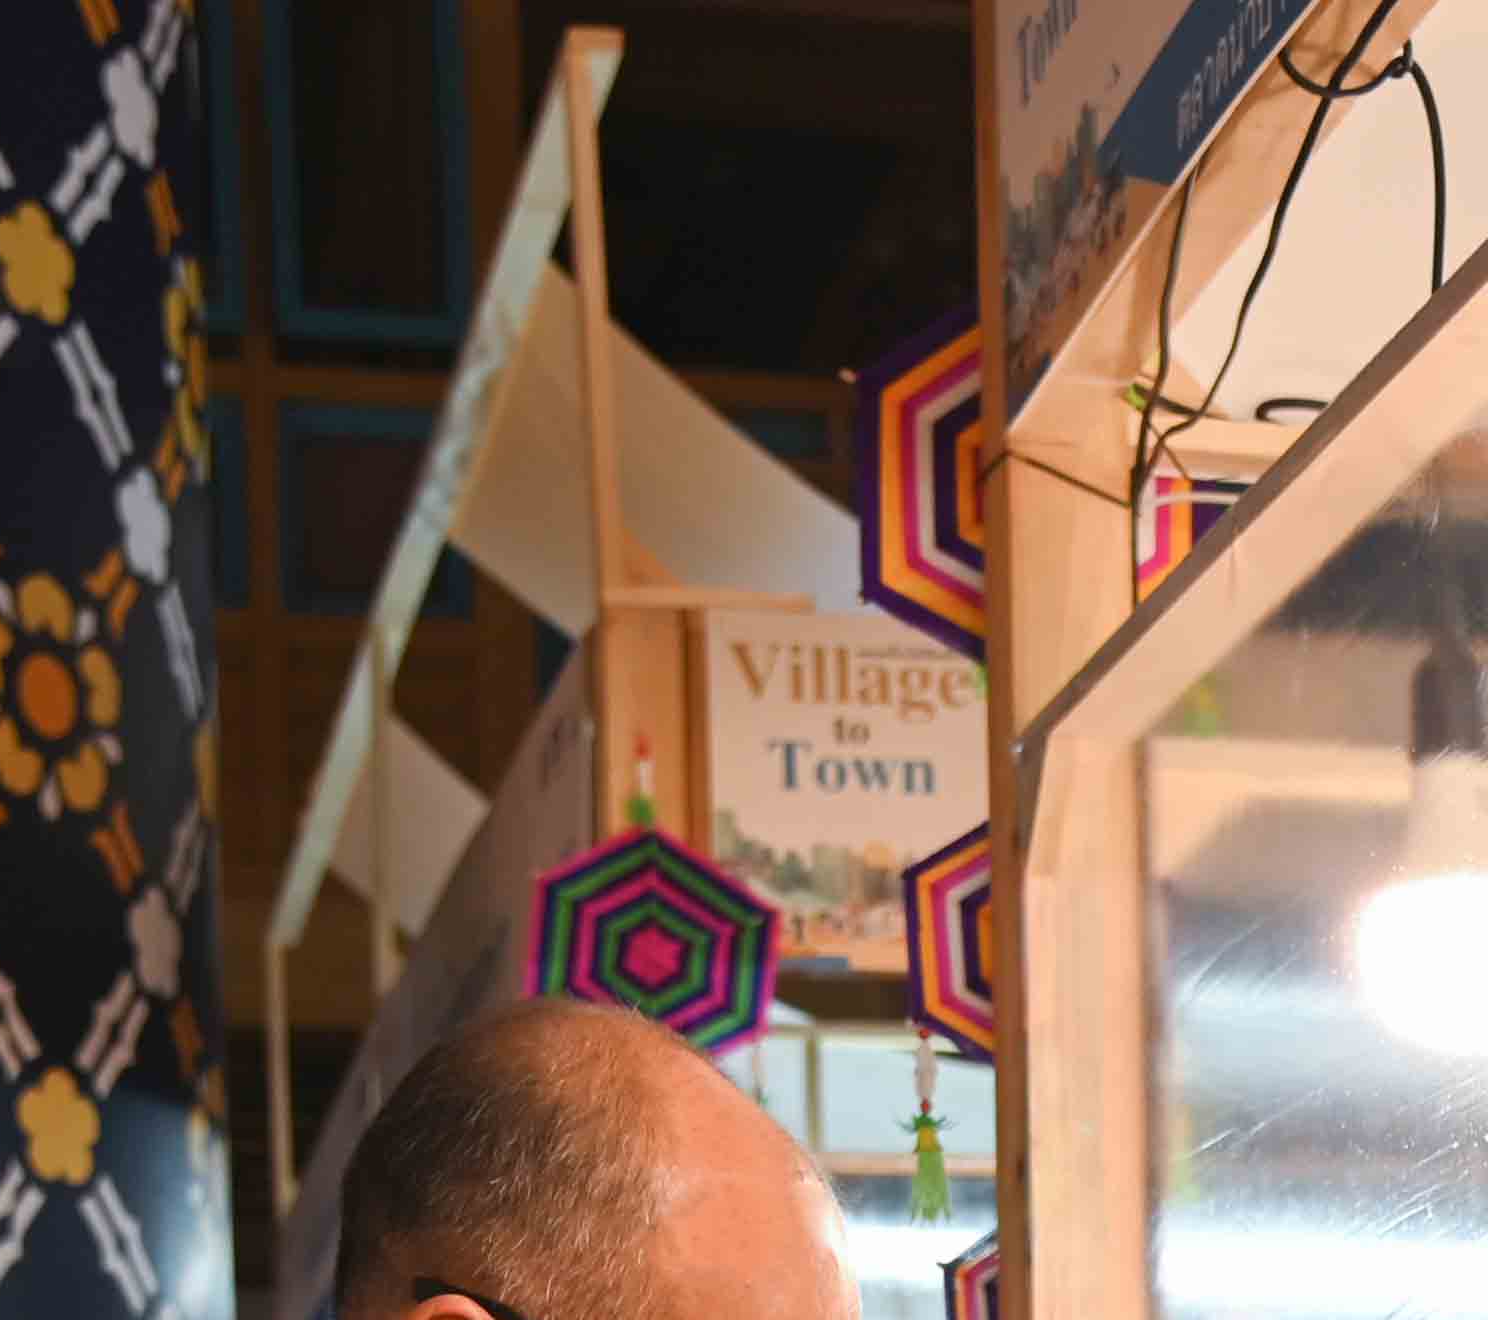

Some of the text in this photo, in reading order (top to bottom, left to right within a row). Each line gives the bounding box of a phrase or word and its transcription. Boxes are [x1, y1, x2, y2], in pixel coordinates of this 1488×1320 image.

[726, 640, 974, 721] Village
[833, 714, 871, 745] to
[768, 740, 938, 796] Town
